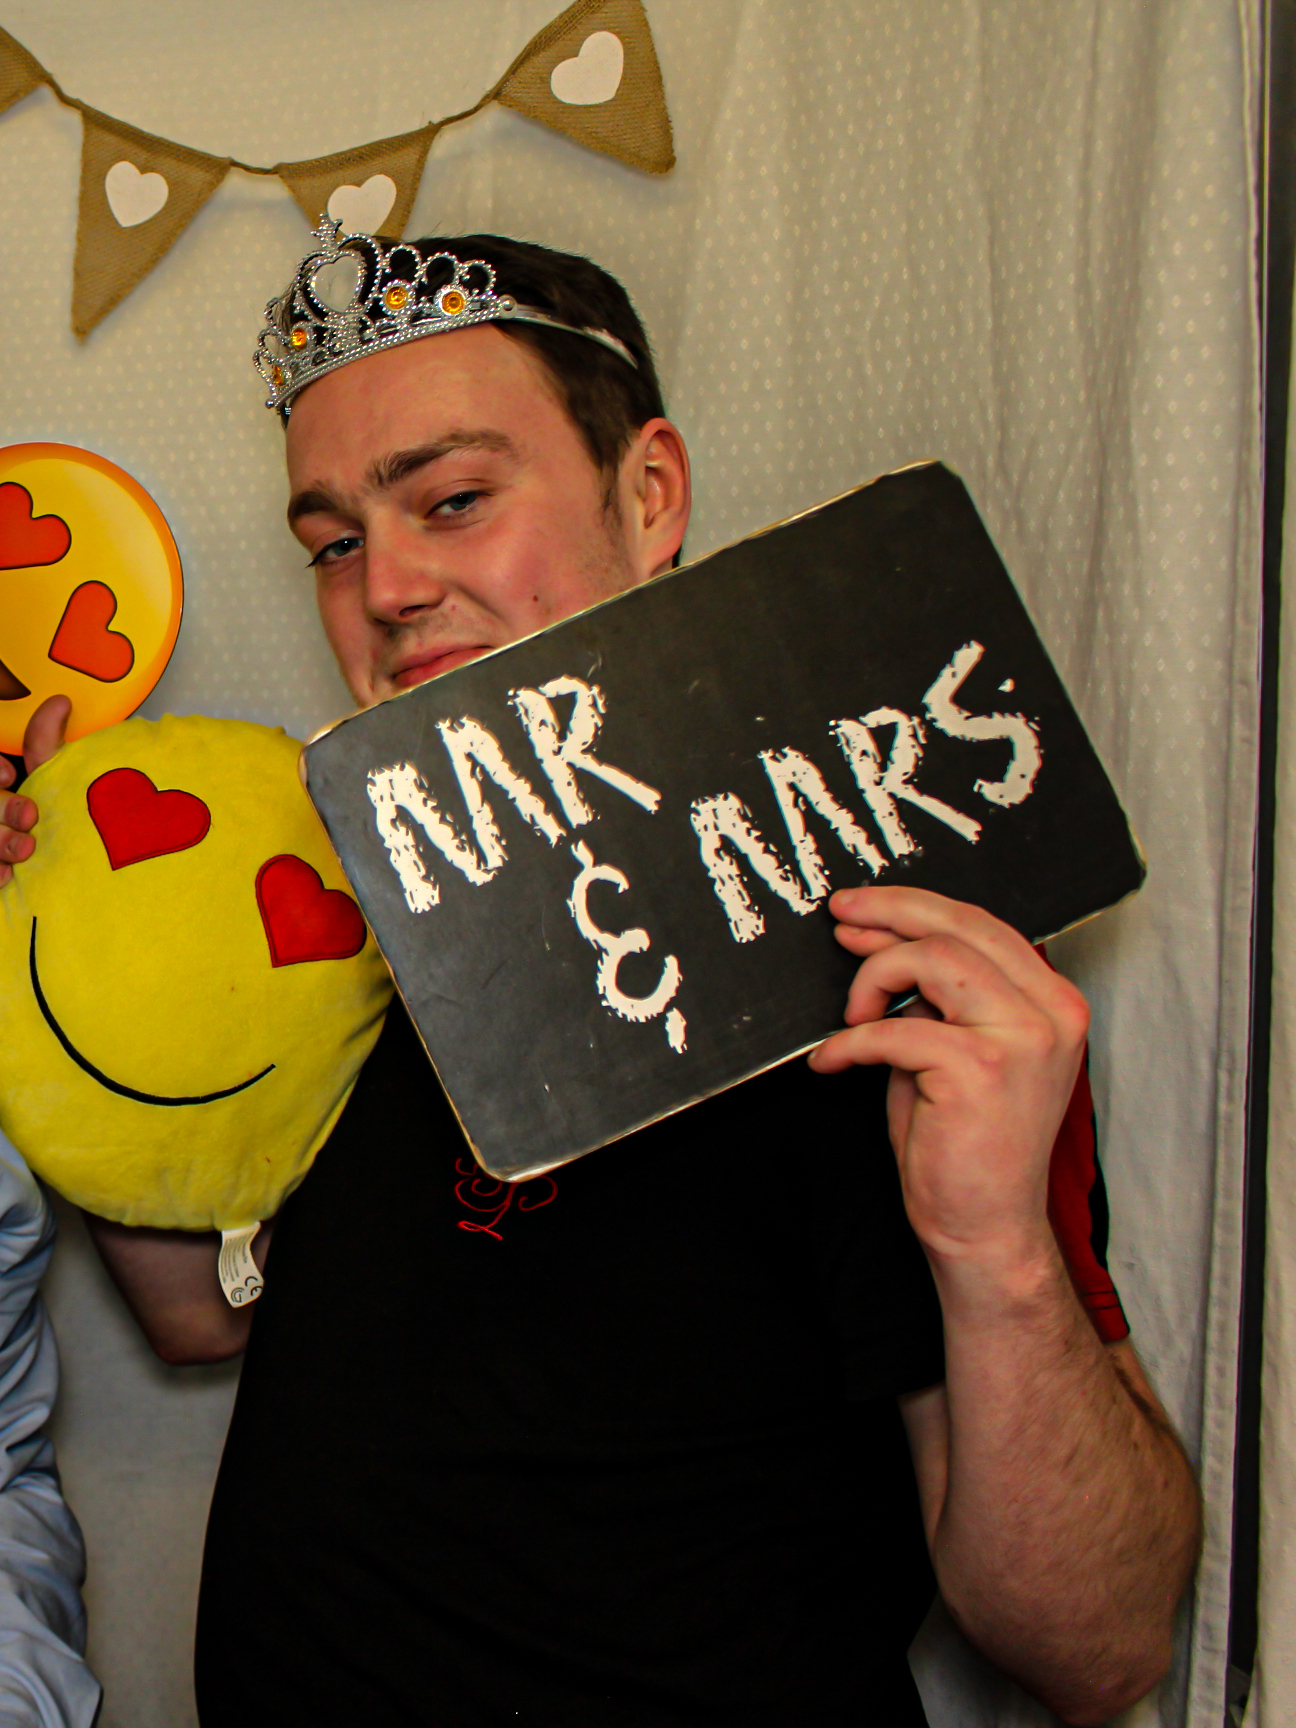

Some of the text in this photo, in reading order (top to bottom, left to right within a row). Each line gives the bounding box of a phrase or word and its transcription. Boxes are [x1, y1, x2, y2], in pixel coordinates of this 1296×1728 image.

[366, 675, 662, 914] MR
[566, 640, 1042, 1054] & MRS
